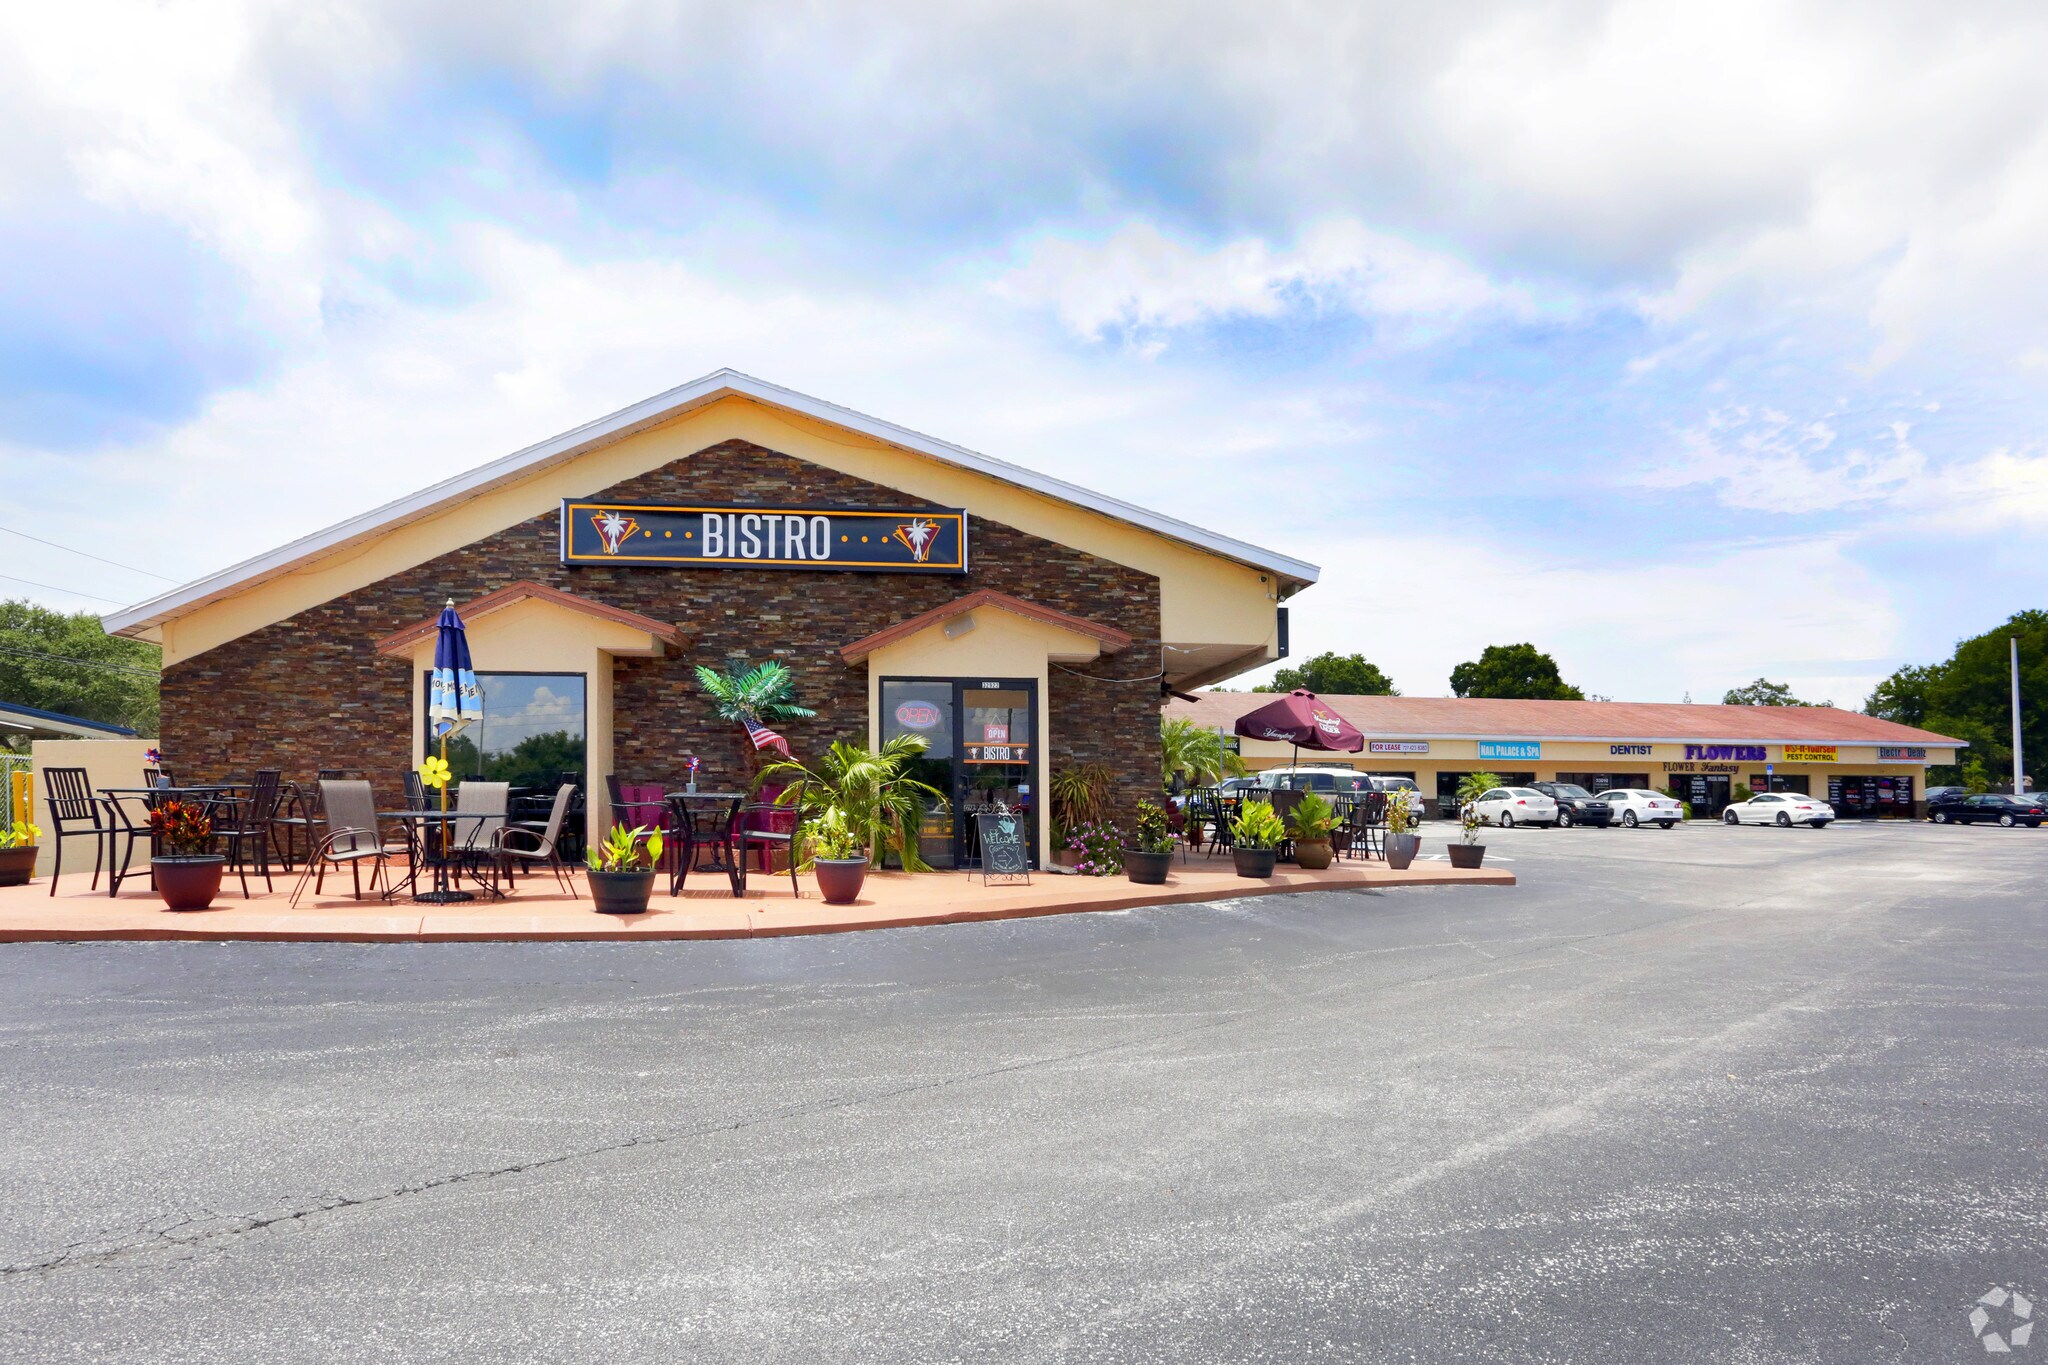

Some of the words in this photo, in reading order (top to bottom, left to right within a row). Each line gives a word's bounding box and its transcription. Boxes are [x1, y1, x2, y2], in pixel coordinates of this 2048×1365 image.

[703, 513, 831, 560] BISTRO
[897, 707, 939, 724] OPEN
[988, 729, 1006, 738] OPEN
[1263, 727, 1296, 740] Yuengling
[983, 746, 1010, 760] BISTRO
[1520, 747, 1526, 757] &
[1610, 745, 1652, 755] DENTIST
[1685, 744, 1767, 761] FLOWERS
[1663, 762, 1695, 772] FLOWER
[1701, 762, 1739, 774] Fantasy
[982, 833, 1021, 844] WELCOME
